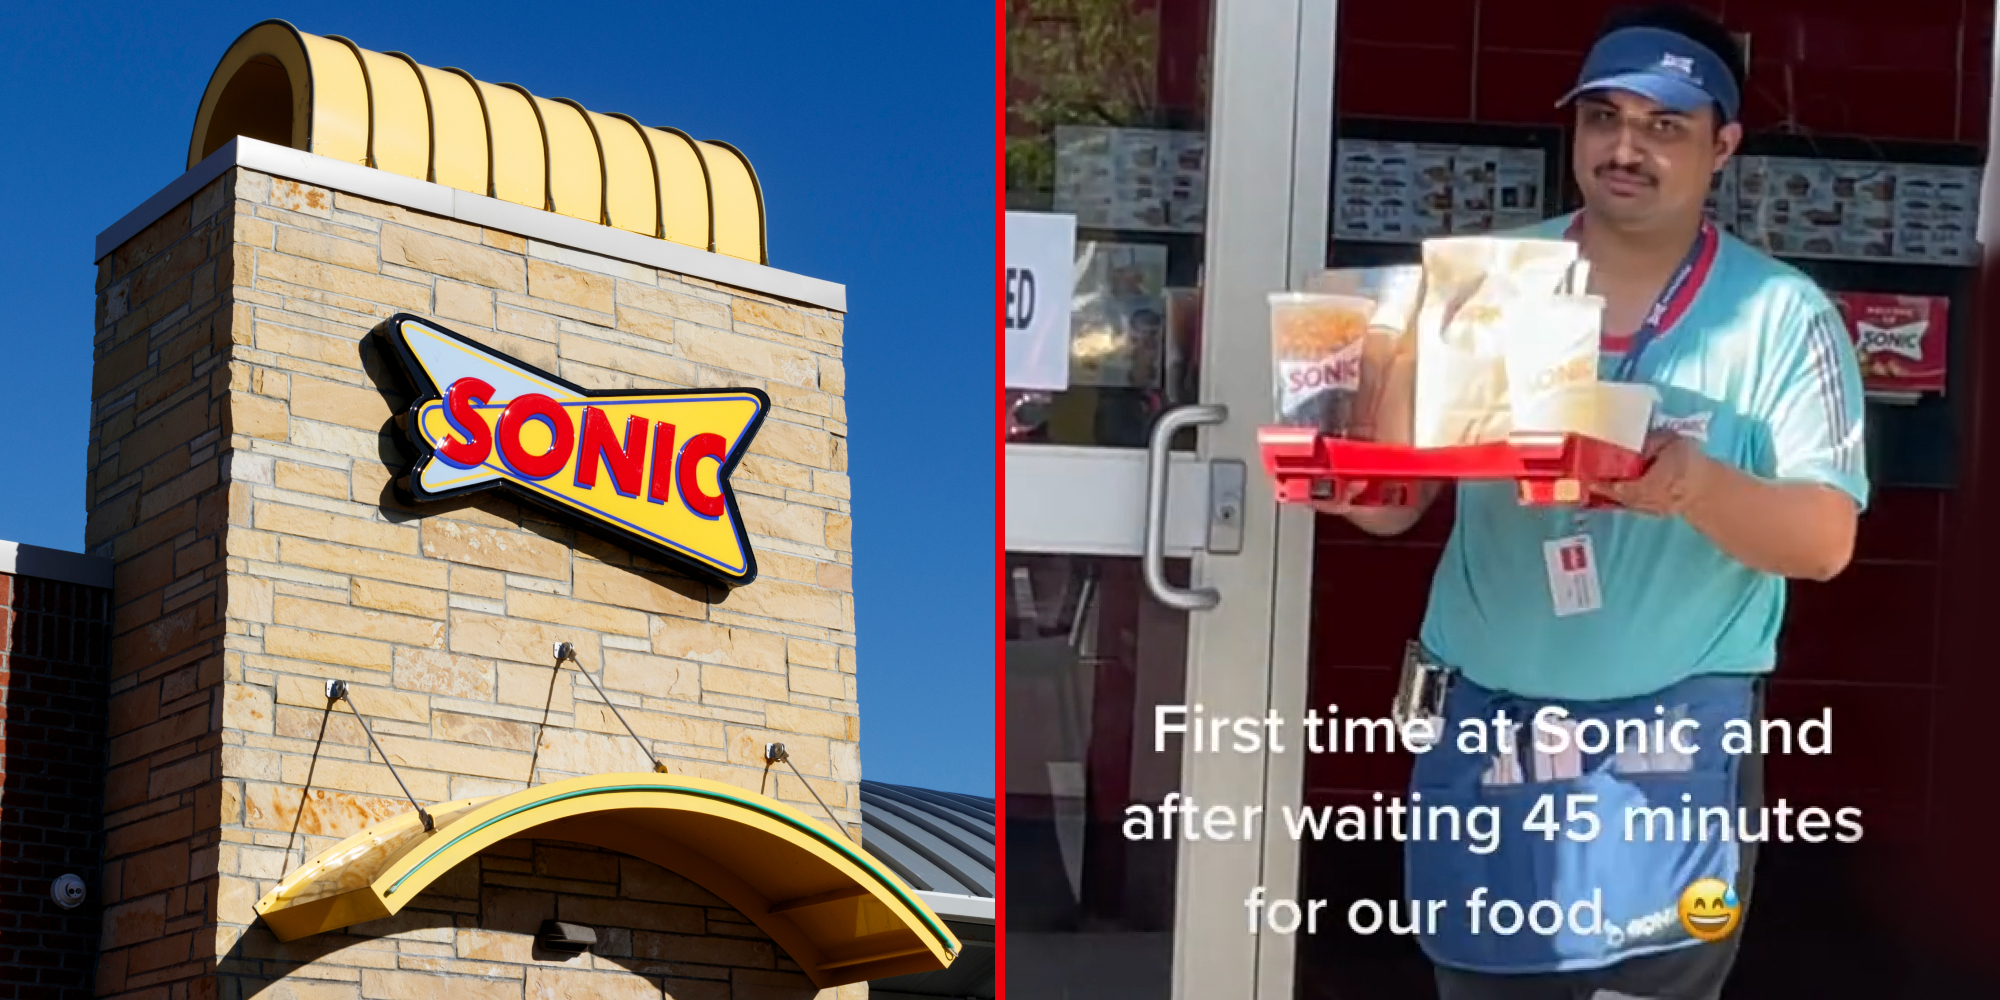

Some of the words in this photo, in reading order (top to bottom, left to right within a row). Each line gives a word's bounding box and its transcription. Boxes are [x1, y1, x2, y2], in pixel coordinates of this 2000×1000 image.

[1005, 269, 1036, 329] ED
[1862, 331, 1918, 348] SONIC
[1289, 357, 1357, 393] SONIC
[437, 376, 727, 517] SONIC
